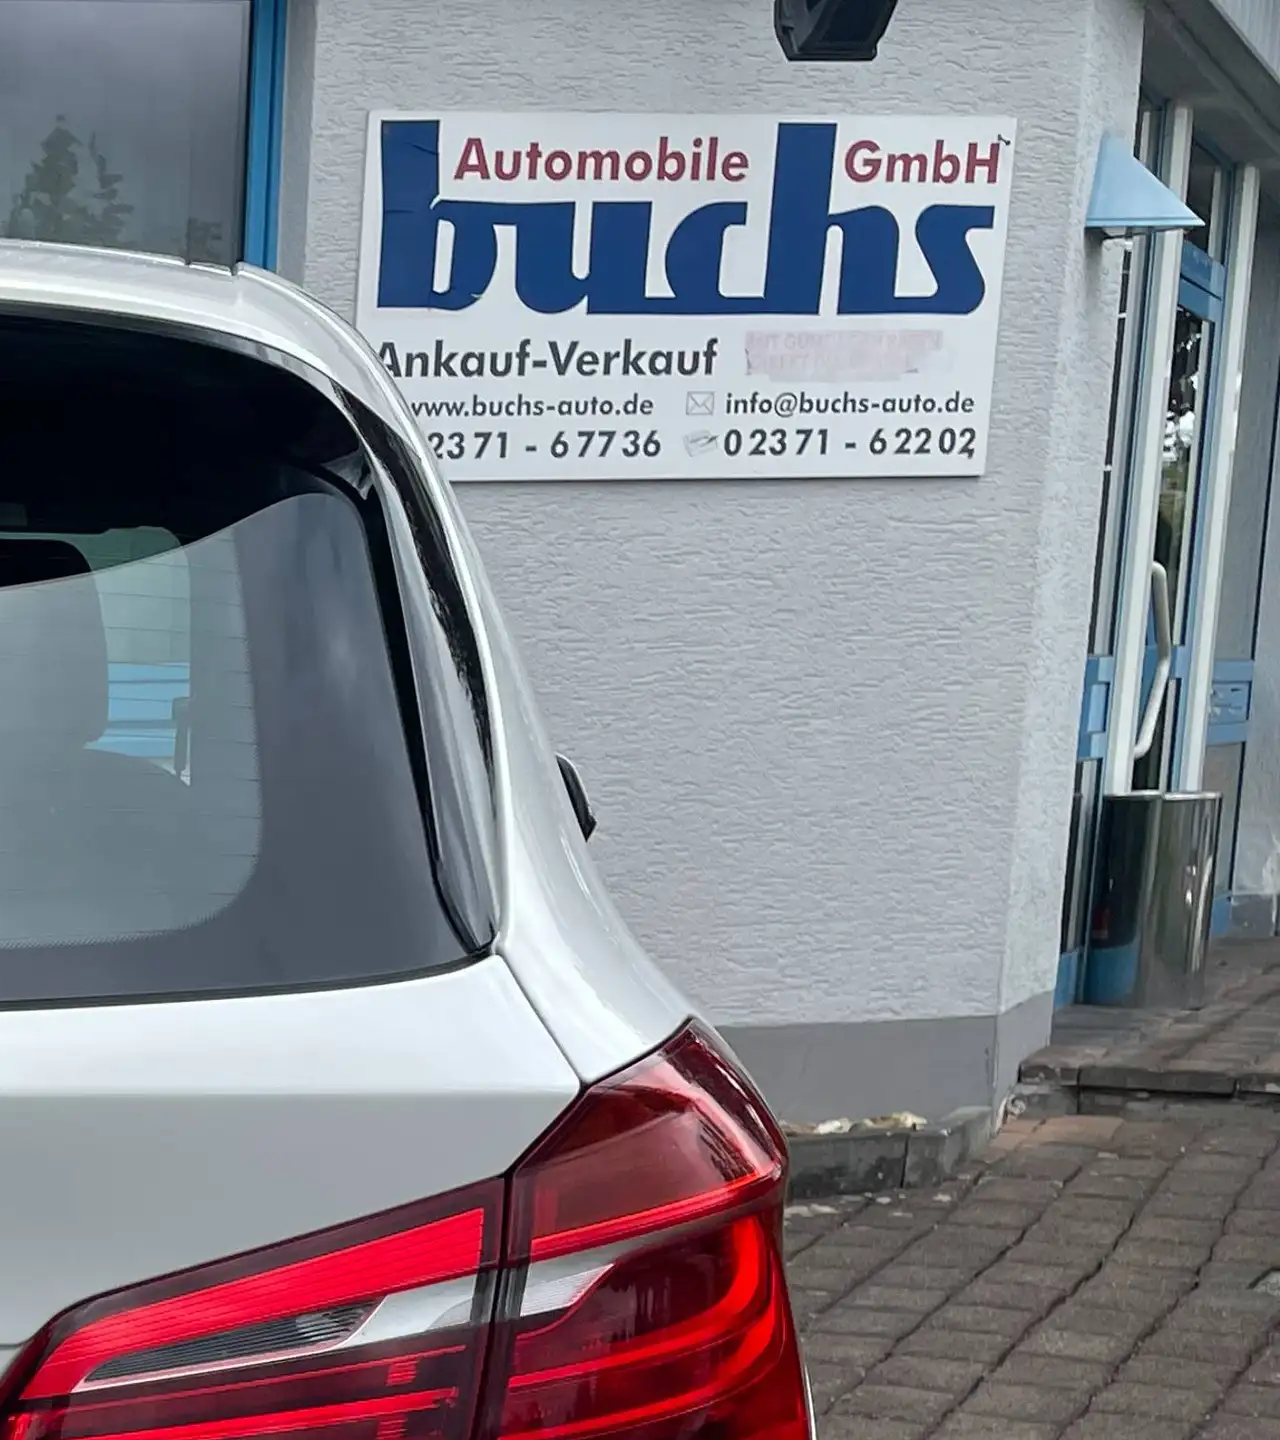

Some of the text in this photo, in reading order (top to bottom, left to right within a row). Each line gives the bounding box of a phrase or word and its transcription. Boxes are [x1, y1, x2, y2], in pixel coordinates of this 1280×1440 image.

[453, 135, 1001, 185] Automobile GmbH
[377, 119, 996, 315] buchs
[378, 337, 719, 379] Ankauf-Verkauf
[725, 390, 975, 418] info@buchs-auto.de
